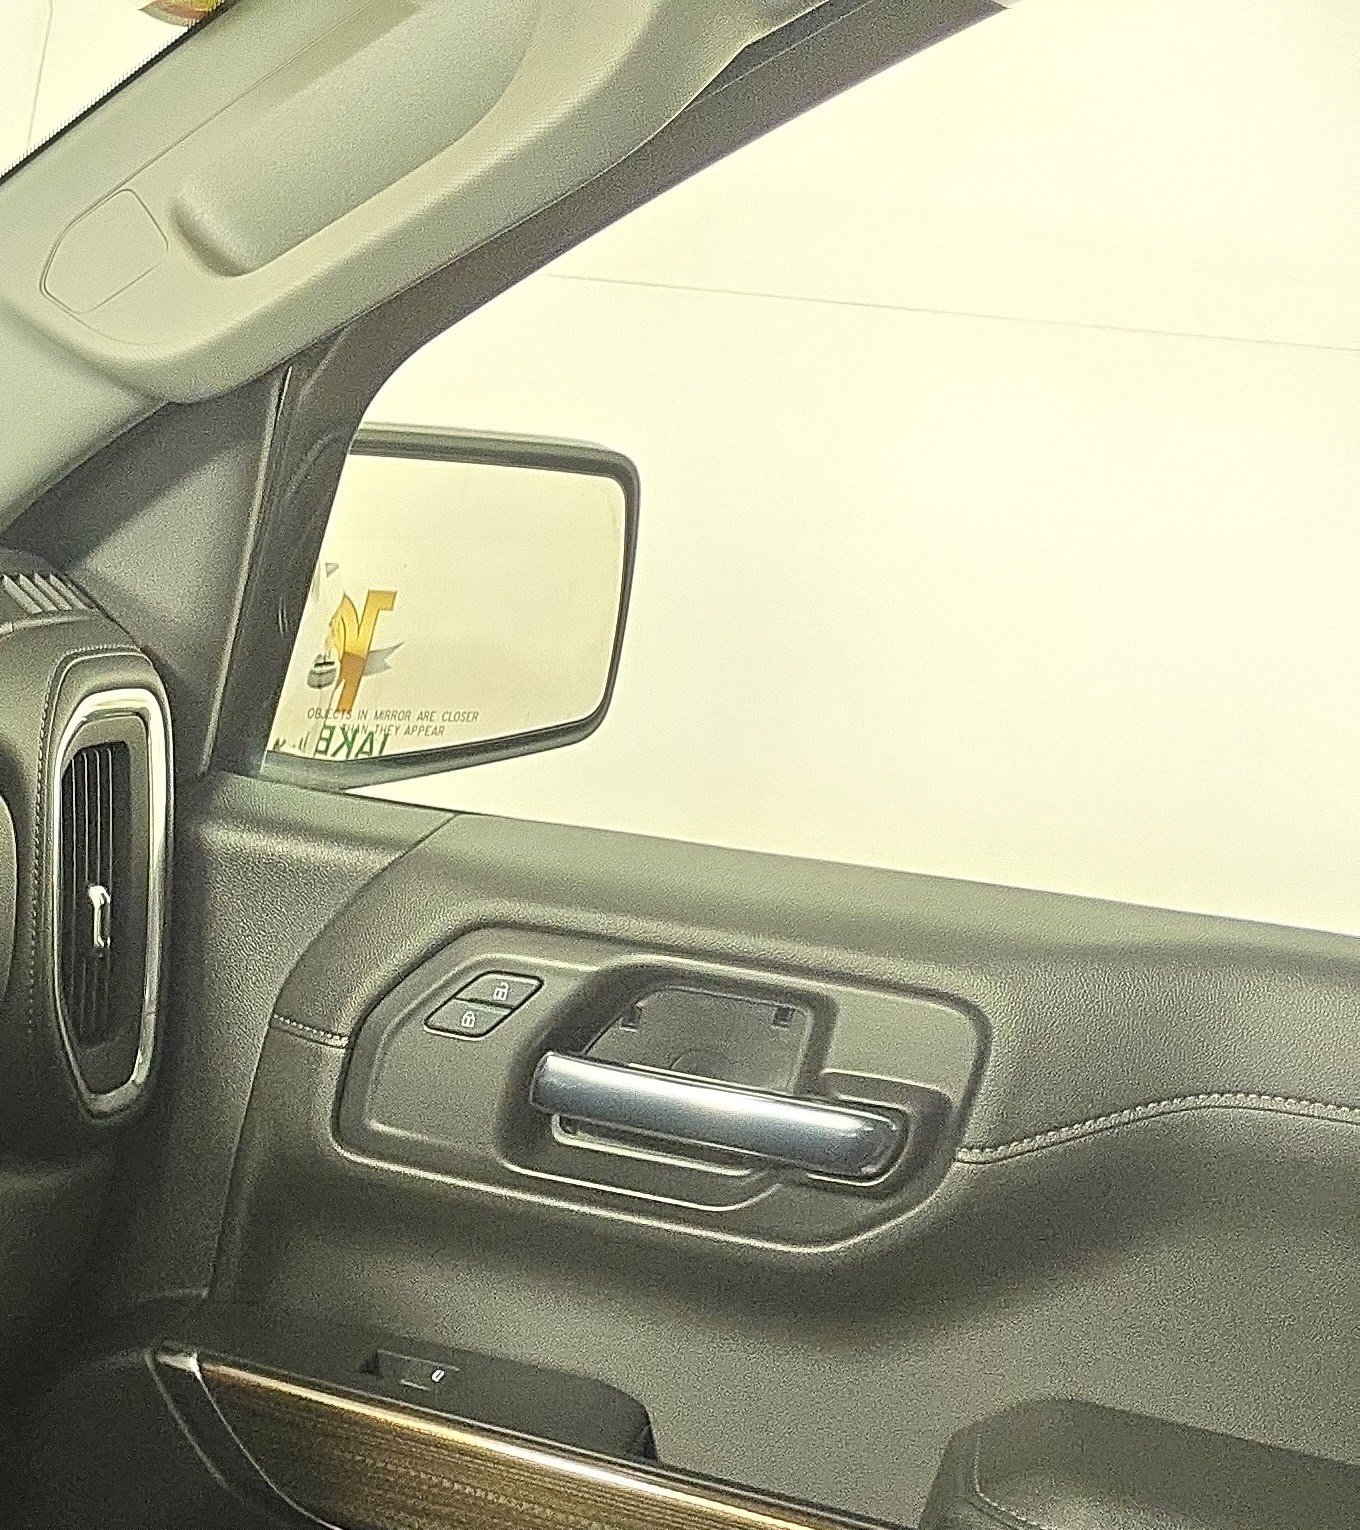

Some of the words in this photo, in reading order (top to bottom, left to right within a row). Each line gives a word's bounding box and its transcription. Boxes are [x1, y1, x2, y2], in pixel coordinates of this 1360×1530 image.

[307, 708, 352, 720] OBJECTS
[358, 709, 368, 720] IN
[373, 709, 411, 721] MIRROR
[417, 711, 437, 722] ARE
[442, 711, 479, 723] CLOSER
[342, 723, 368, 735] THAN
[374, 724, 400, 736] THEY
[404, 725, 445, 737] APPEAR
